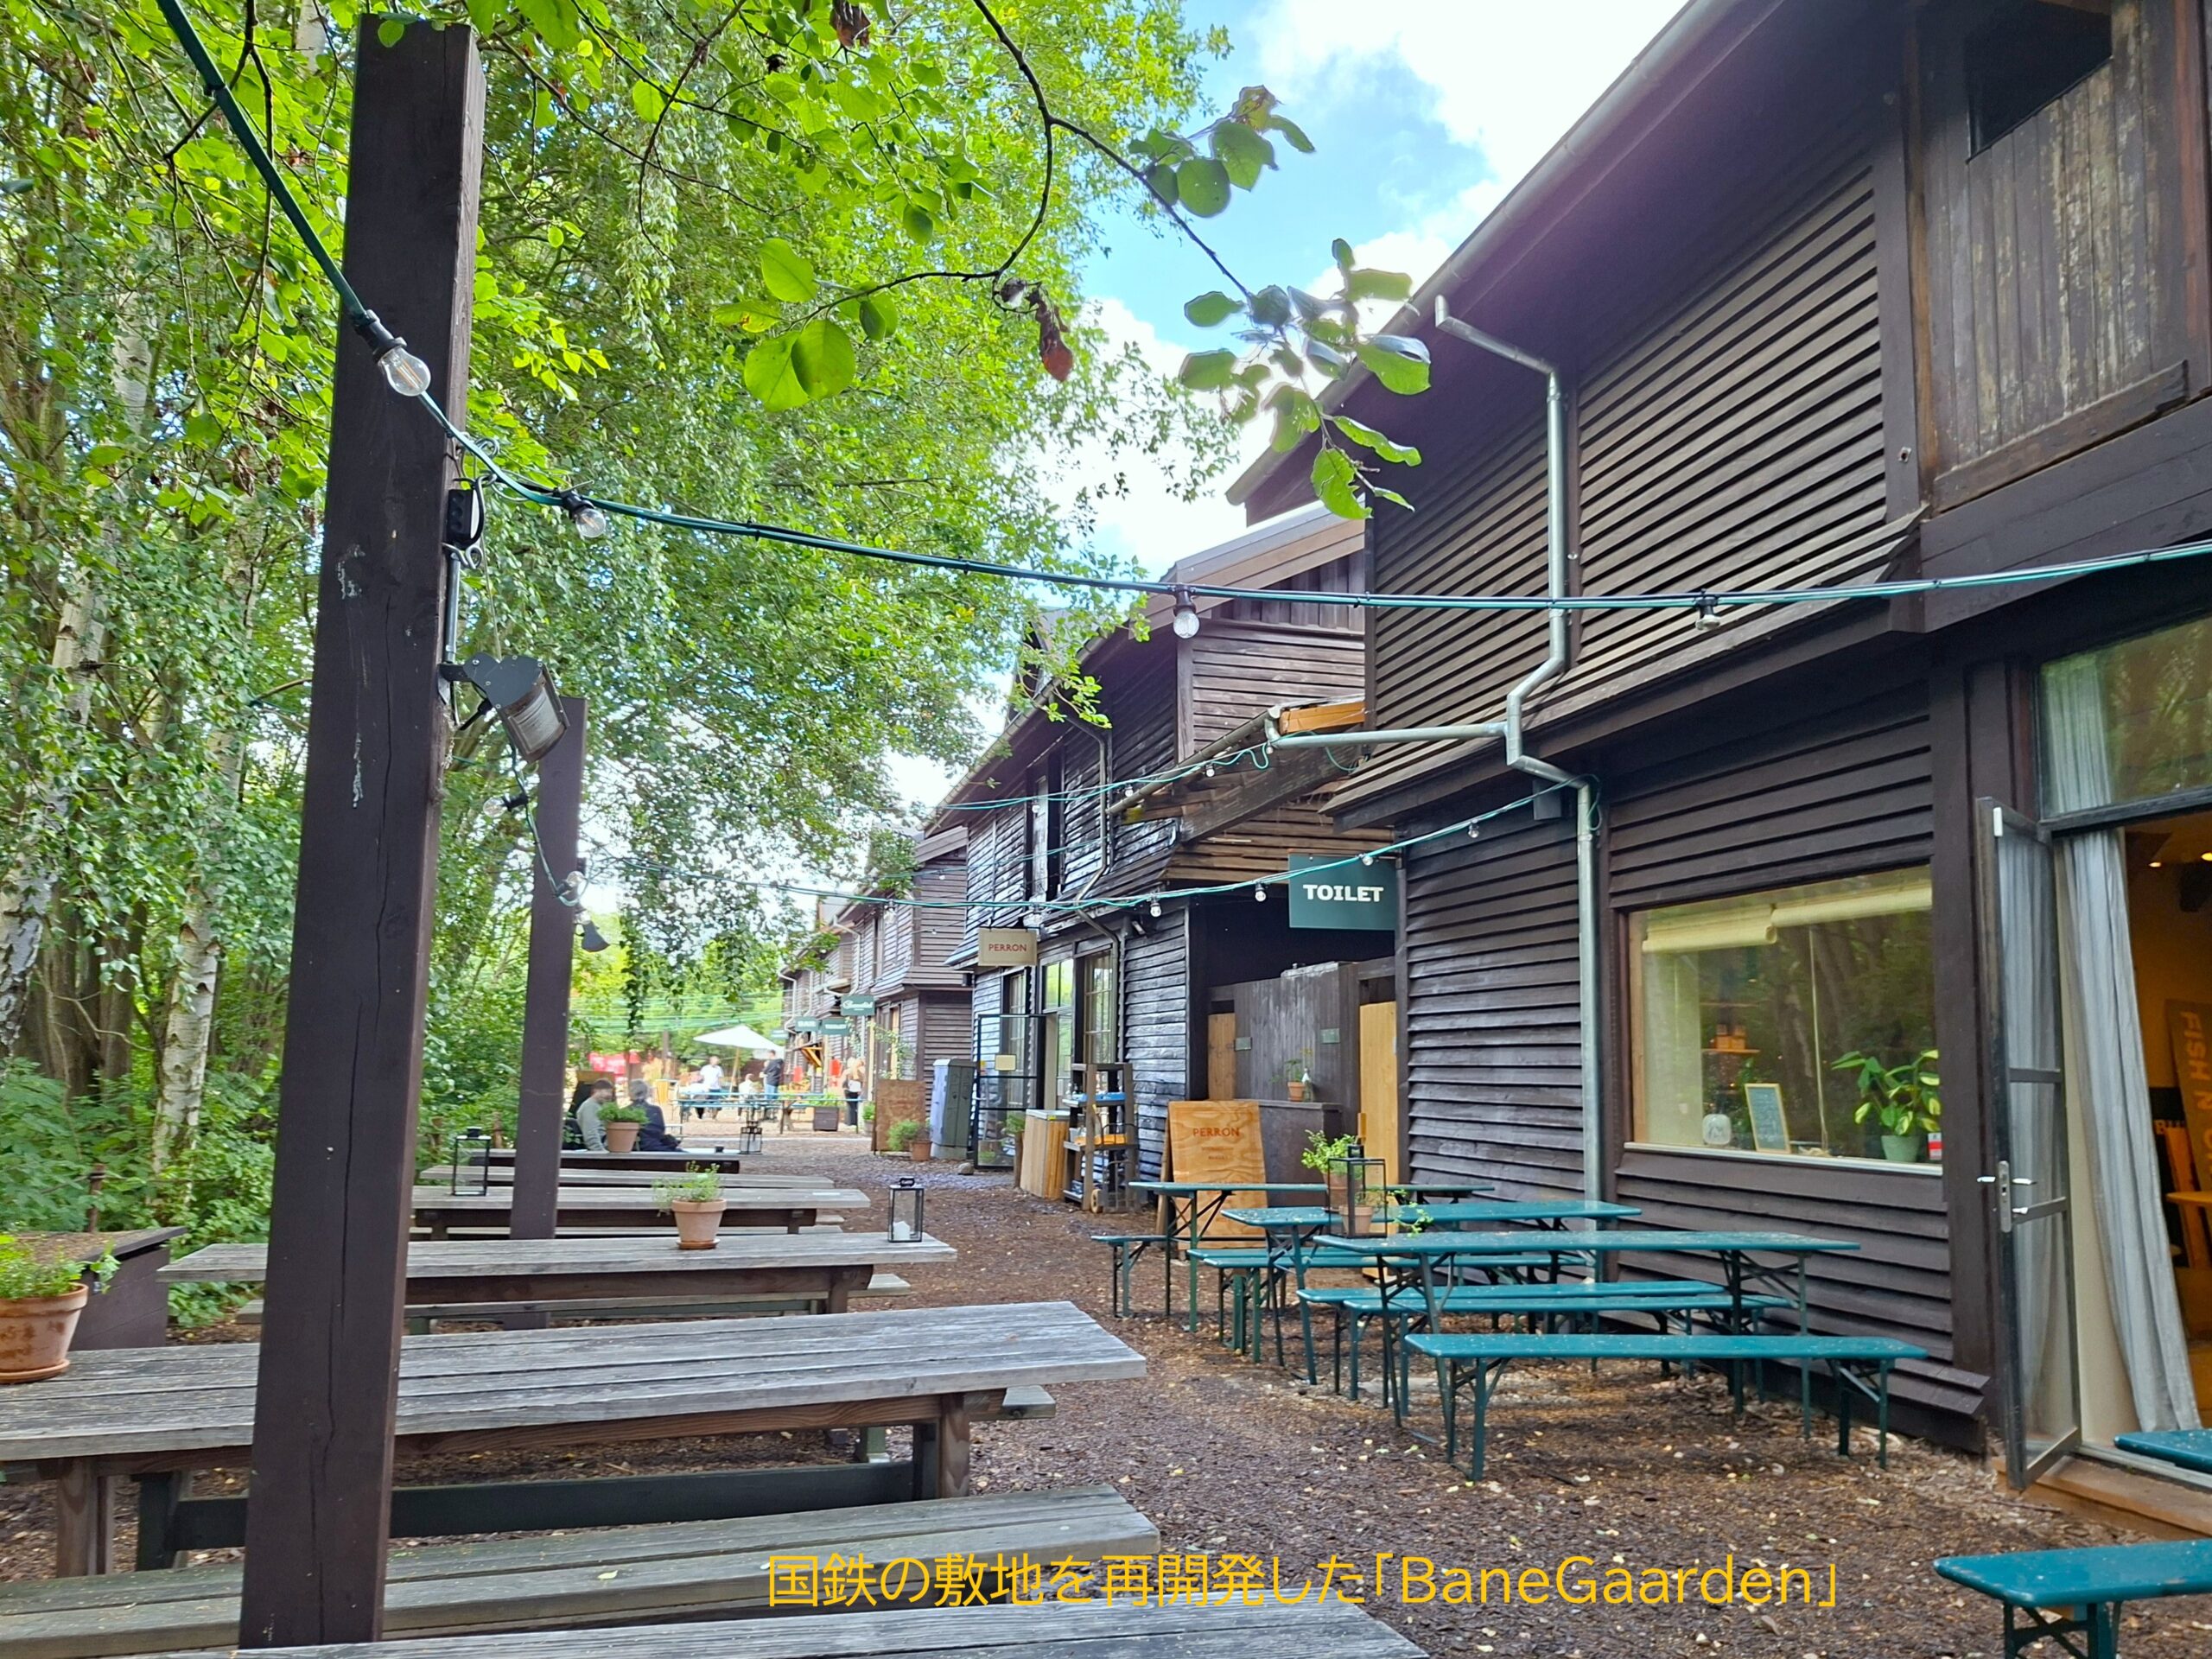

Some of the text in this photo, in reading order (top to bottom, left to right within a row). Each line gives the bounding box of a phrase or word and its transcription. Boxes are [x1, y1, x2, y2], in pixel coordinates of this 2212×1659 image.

[1302, 884, 1384, 903] TOILET
[988, 943, 1027, 952] PERRON
[2180, 1011, 2210, 1081] FISH
[1192, 1126, 1240, 1138] PERRON
